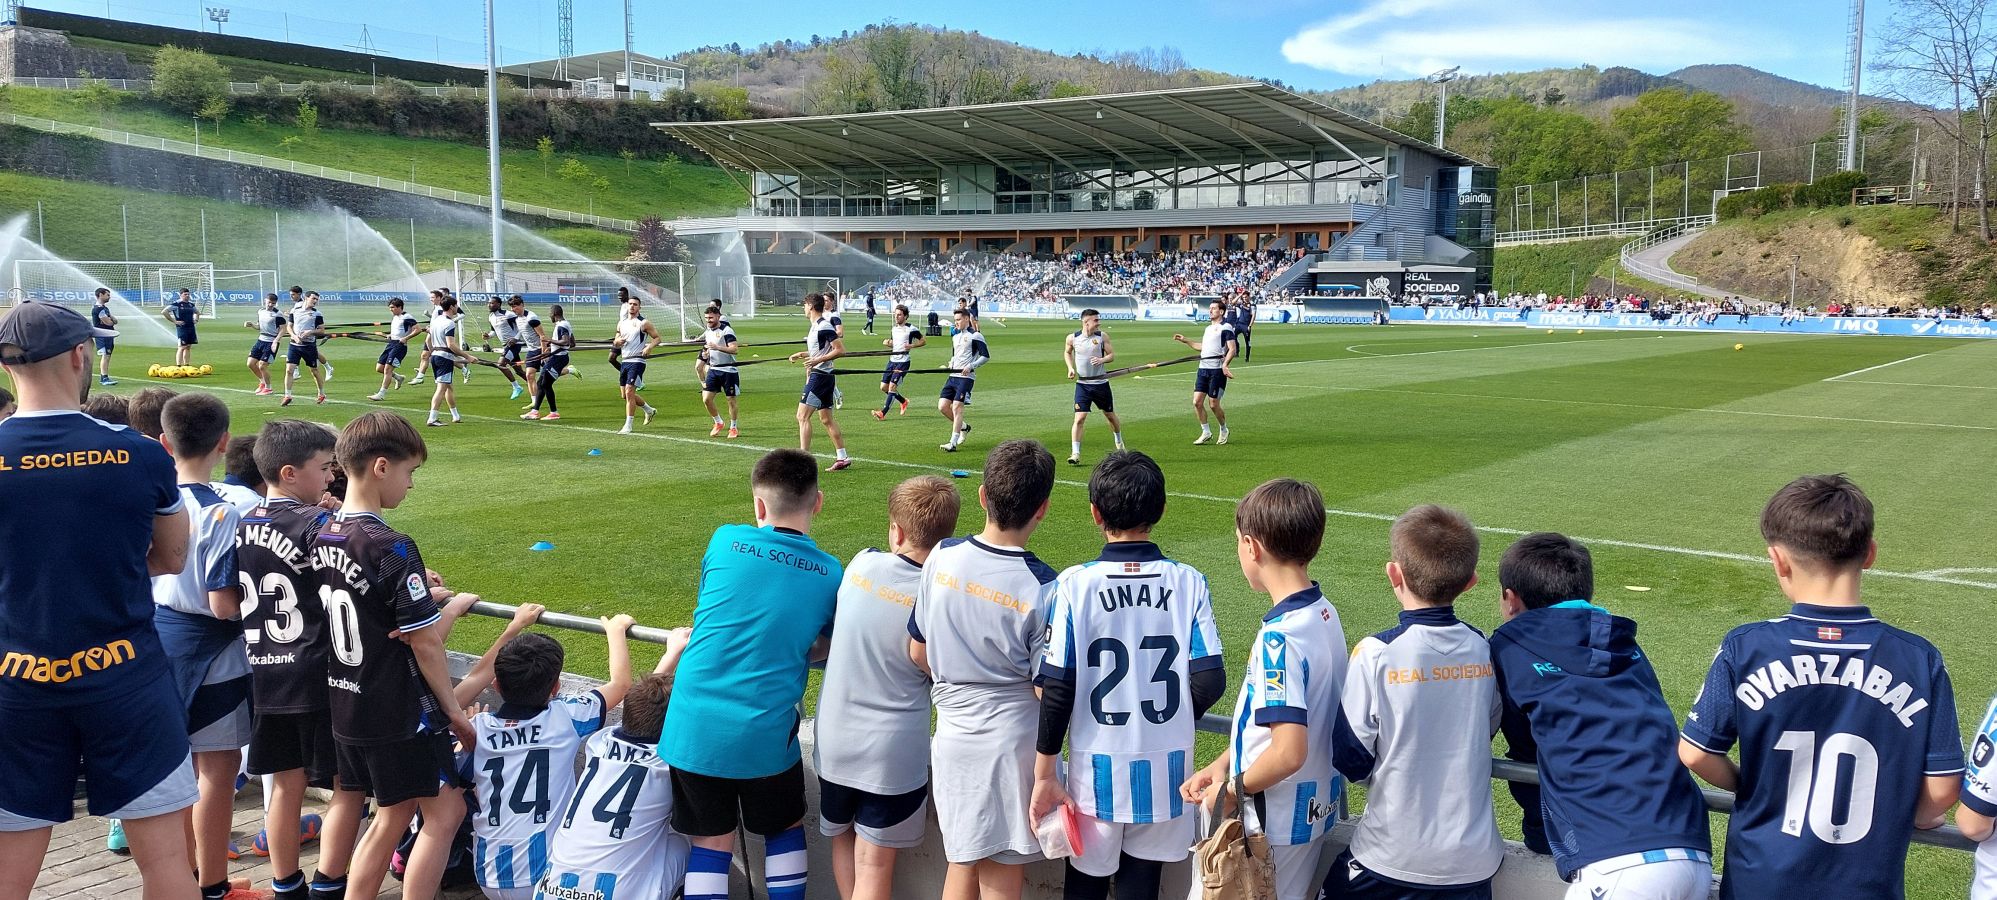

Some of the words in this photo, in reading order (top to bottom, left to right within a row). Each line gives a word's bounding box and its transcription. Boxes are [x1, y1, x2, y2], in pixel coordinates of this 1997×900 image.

[1404, 273, 1432, 281] REAL
[1404, 283, 1460, 293] SOCIEDAD
[229, 293, 254, 301] group
[559, 295, 599, 303] macron
[1439, 309, 1489, 320] YASUDA
[1539, 313, 1601, 326] macron
[1832, 319, 1879, 334] IMQ
[1936, 322, 1991, 336] Halcón
[20, 449, 130, 470] SOCIEDAD
[730, 541, 764, 558] REAL
[768, 549, 828, 576] SOCIEDAD
[850, 573, 873, 593] REAL
[877, 584, 915, 609] SOCIE
[936, 572, 960, 591] REAL
[964, 581, 1031, 615] SOCIEDAD
[1098, 583, 1173, 612] UNAX
[0, 639, 136, 683] macron
[1087, 635, 1180, 726] 23
[1388, 666, 1430, 684] REAL
[1735, 654, 1929, 728] OYARZABAL
[486, 724, 542, 750] TAKE
[482, 748, 550, 827] 14
[562, 756, 649, 840] 14
[1773, 730, 1879, 844] 10
[538, 869, 606, 900] Kutxabank
